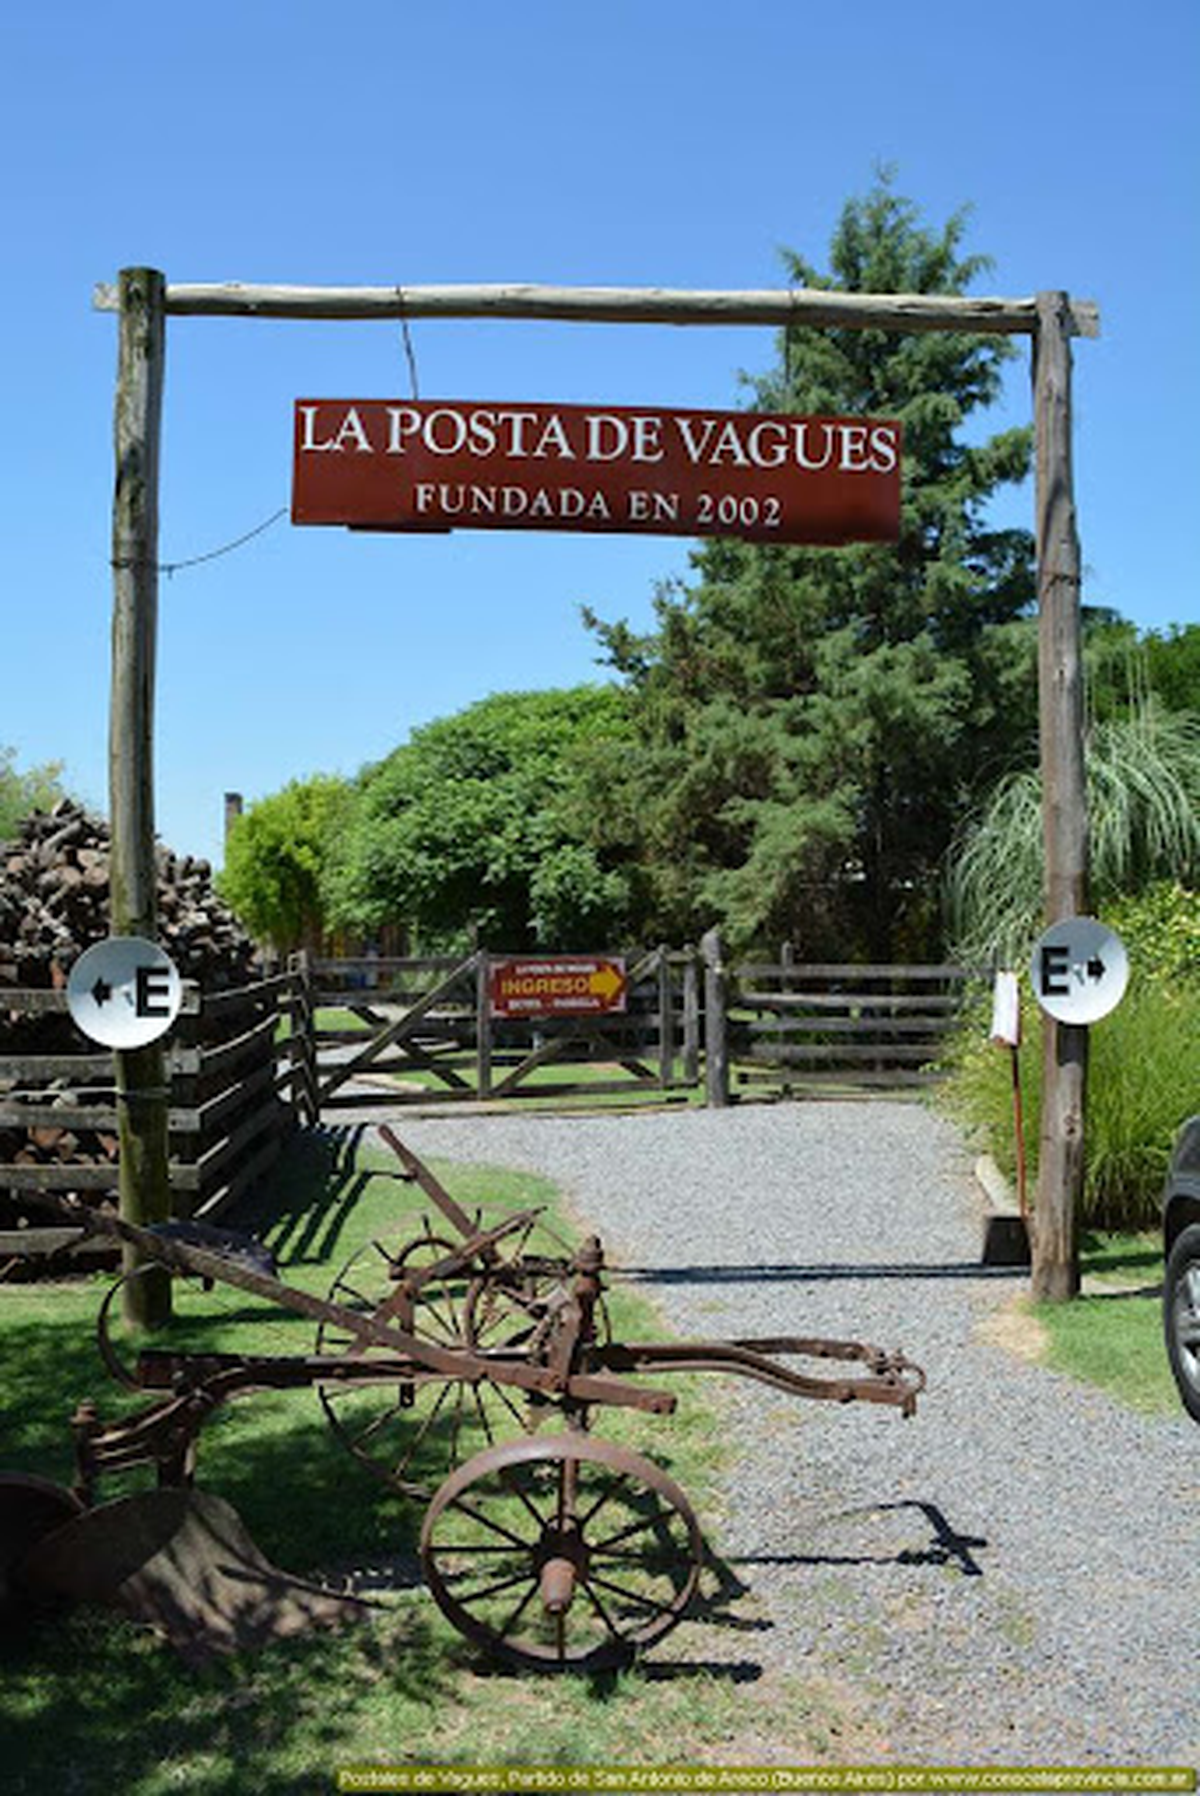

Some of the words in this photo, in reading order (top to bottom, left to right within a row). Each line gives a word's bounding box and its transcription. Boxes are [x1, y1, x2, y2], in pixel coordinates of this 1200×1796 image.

[300, 406, 374, 452] LA
[386, 408, 574, 460] POSTA
[585, 416, 664, 463] DE
[674, 418, 897, 474] VAGUES
[415, 483, 611, 519] FUNDADA
[628, 492, 679, 520] EN
[697, 494, 781, 526] 2002
[136, 966, 169, 1018] E
[501, 977, 589, 995] INGRESO
[1041, 946, 1069, 995] E
